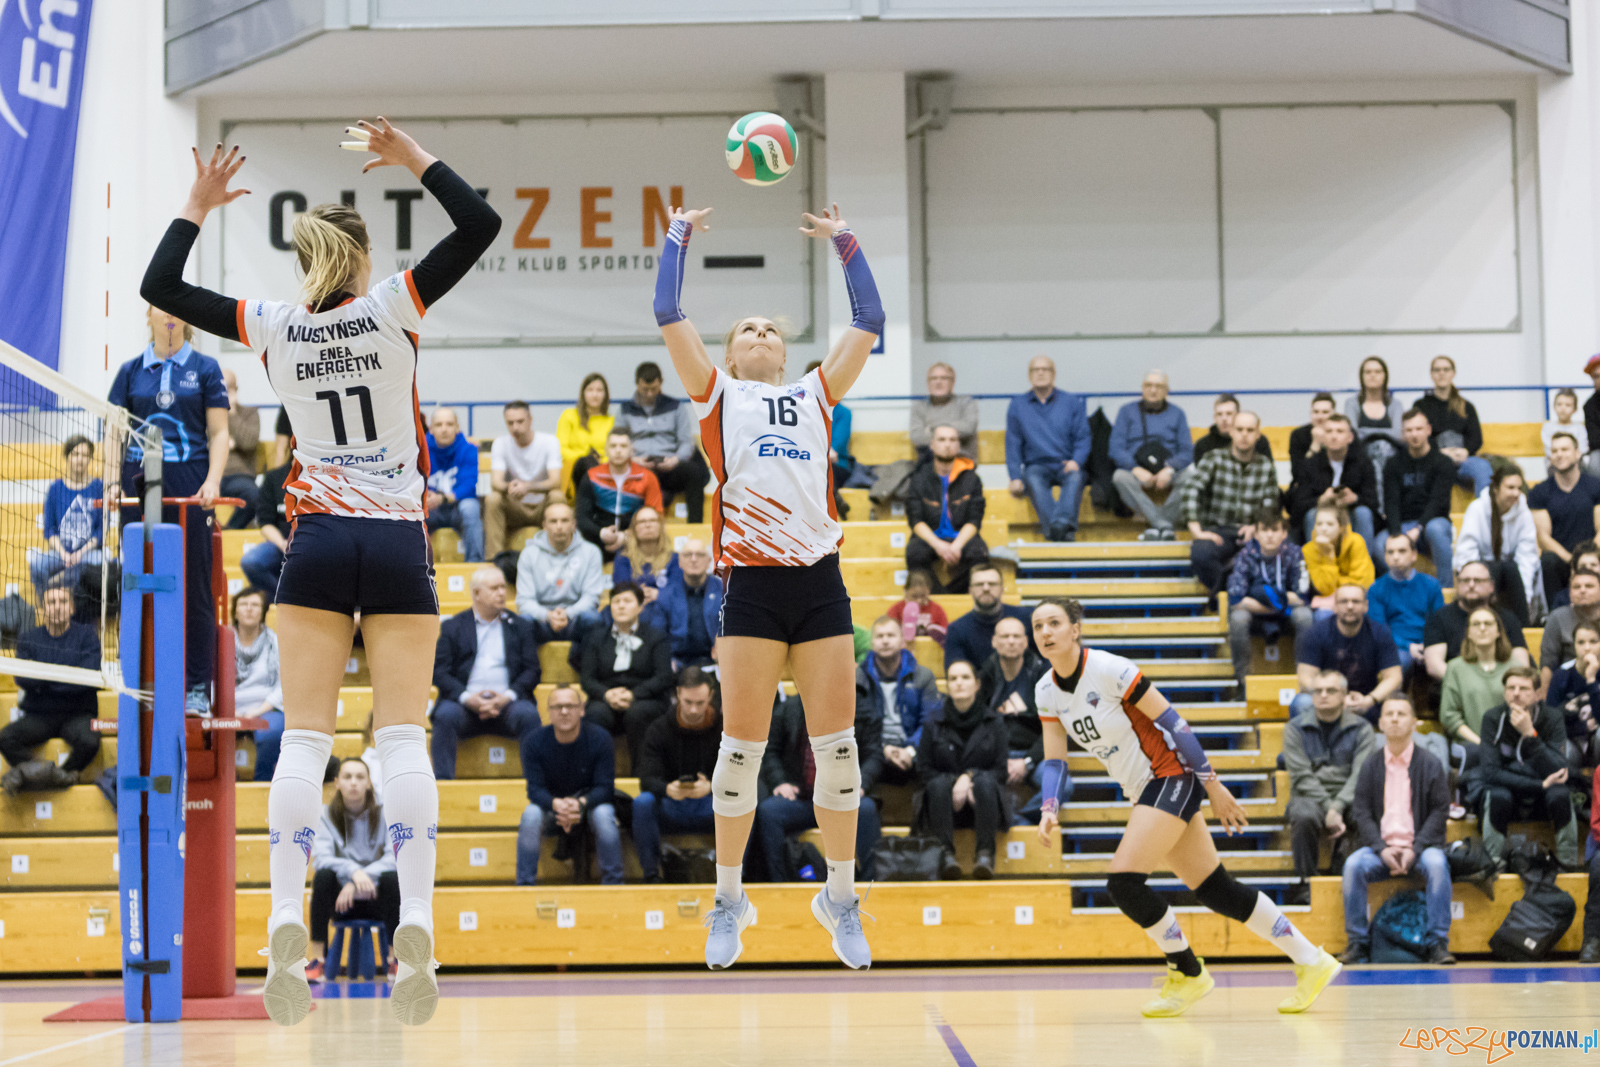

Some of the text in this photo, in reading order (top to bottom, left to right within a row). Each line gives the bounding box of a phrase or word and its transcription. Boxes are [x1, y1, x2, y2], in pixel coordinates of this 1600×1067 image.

[518, 256, 567, 271] KLUB
[579, 254, 661, 271] SPORTO
[287, 316, 380, 343] MUSZYŃSKA
[296, 352, 382, 381] ENERGETYK
[319, 346, 353, 361] ENEA
[315, 385, 377, 446] 11
[762, 395, 798, 427] 16
[758, 443, 811, 461] Enea
[1072, 715, 1101, 743] 99
[184, 798, 213, 810] noh
